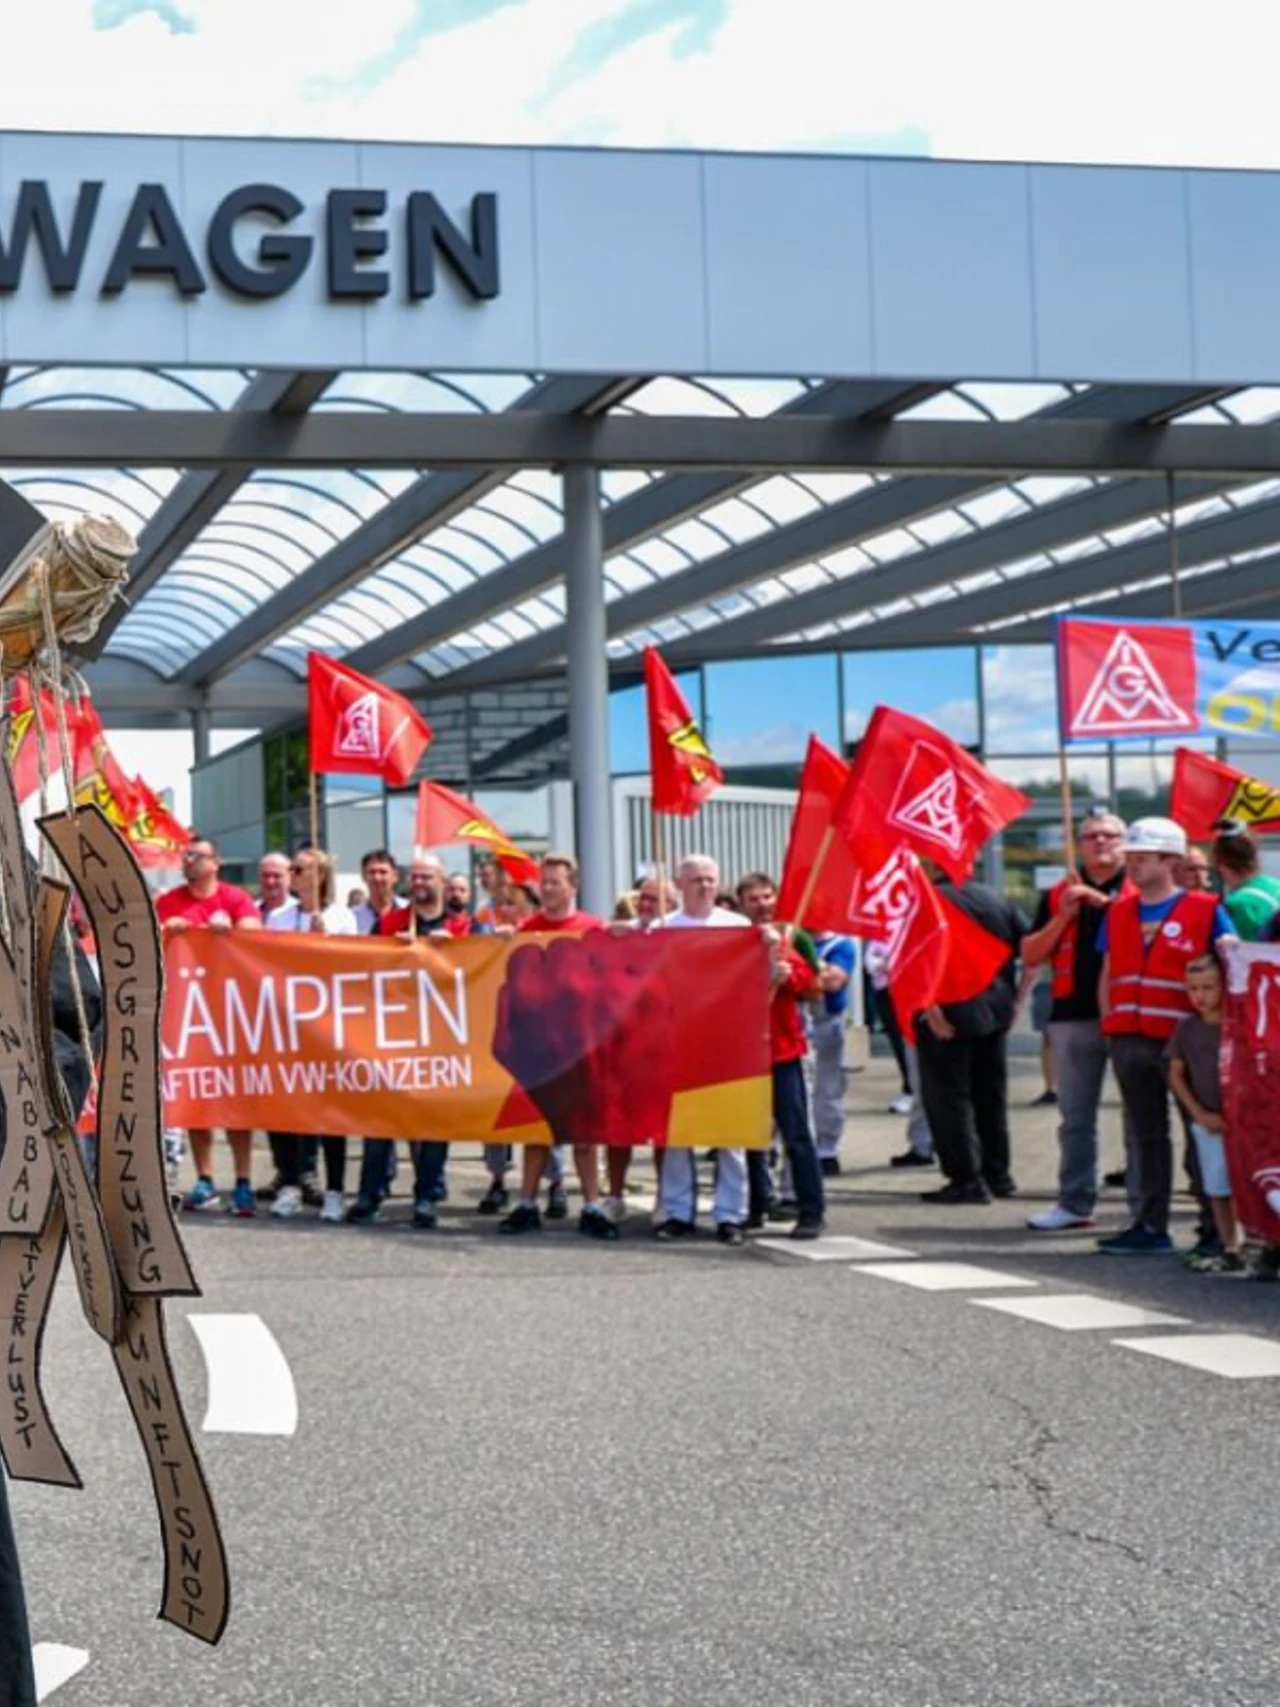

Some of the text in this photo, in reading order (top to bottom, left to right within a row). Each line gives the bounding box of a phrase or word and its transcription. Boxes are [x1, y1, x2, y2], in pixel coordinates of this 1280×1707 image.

[1207, 694, 1280, 733] O
[78, 832, 162, 1284] AUSGRENZUNG
[242, 1062, 273, 1095] IM
[278, 1054, 473, 1095] VW-KONZERN
